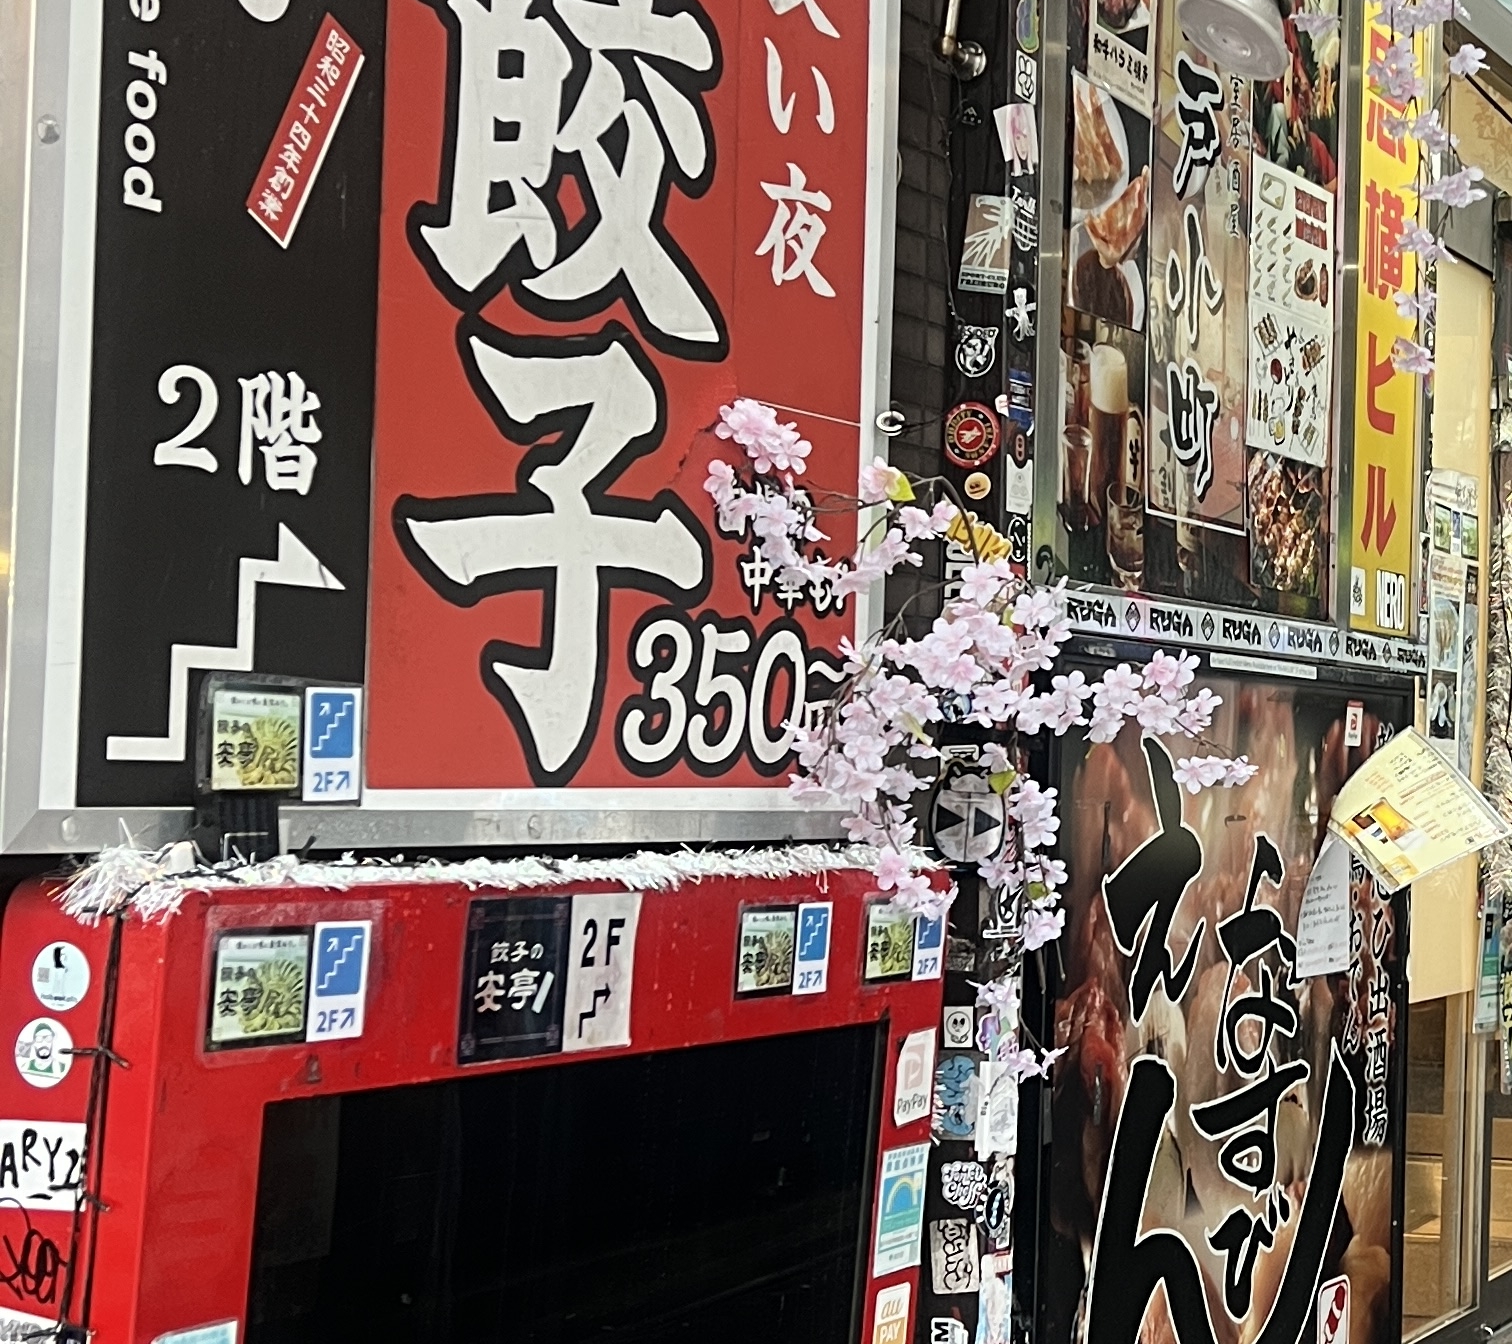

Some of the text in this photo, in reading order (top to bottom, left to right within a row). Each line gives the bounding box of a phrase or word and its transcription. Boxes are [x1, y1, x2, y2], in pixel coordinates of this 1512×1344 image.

[122, 49, 168, 214] food
[152, 364, 323, 496] 2階
[1149, 605, 1194, 640] RUGA
[1222, 617, 1262, 647] RUGA
[1287, 628, 1323, 654] RUGA
[1345, 635, 1377, 661] RUGA
[313, 771, 334, 793] 2F
[581, 917, 627, 969] 2F
[316, 1009, 339, 1033] 2F
[895, 1093, 928, 1116] PayPay
[878, 1321, 902, 1344] PAY
